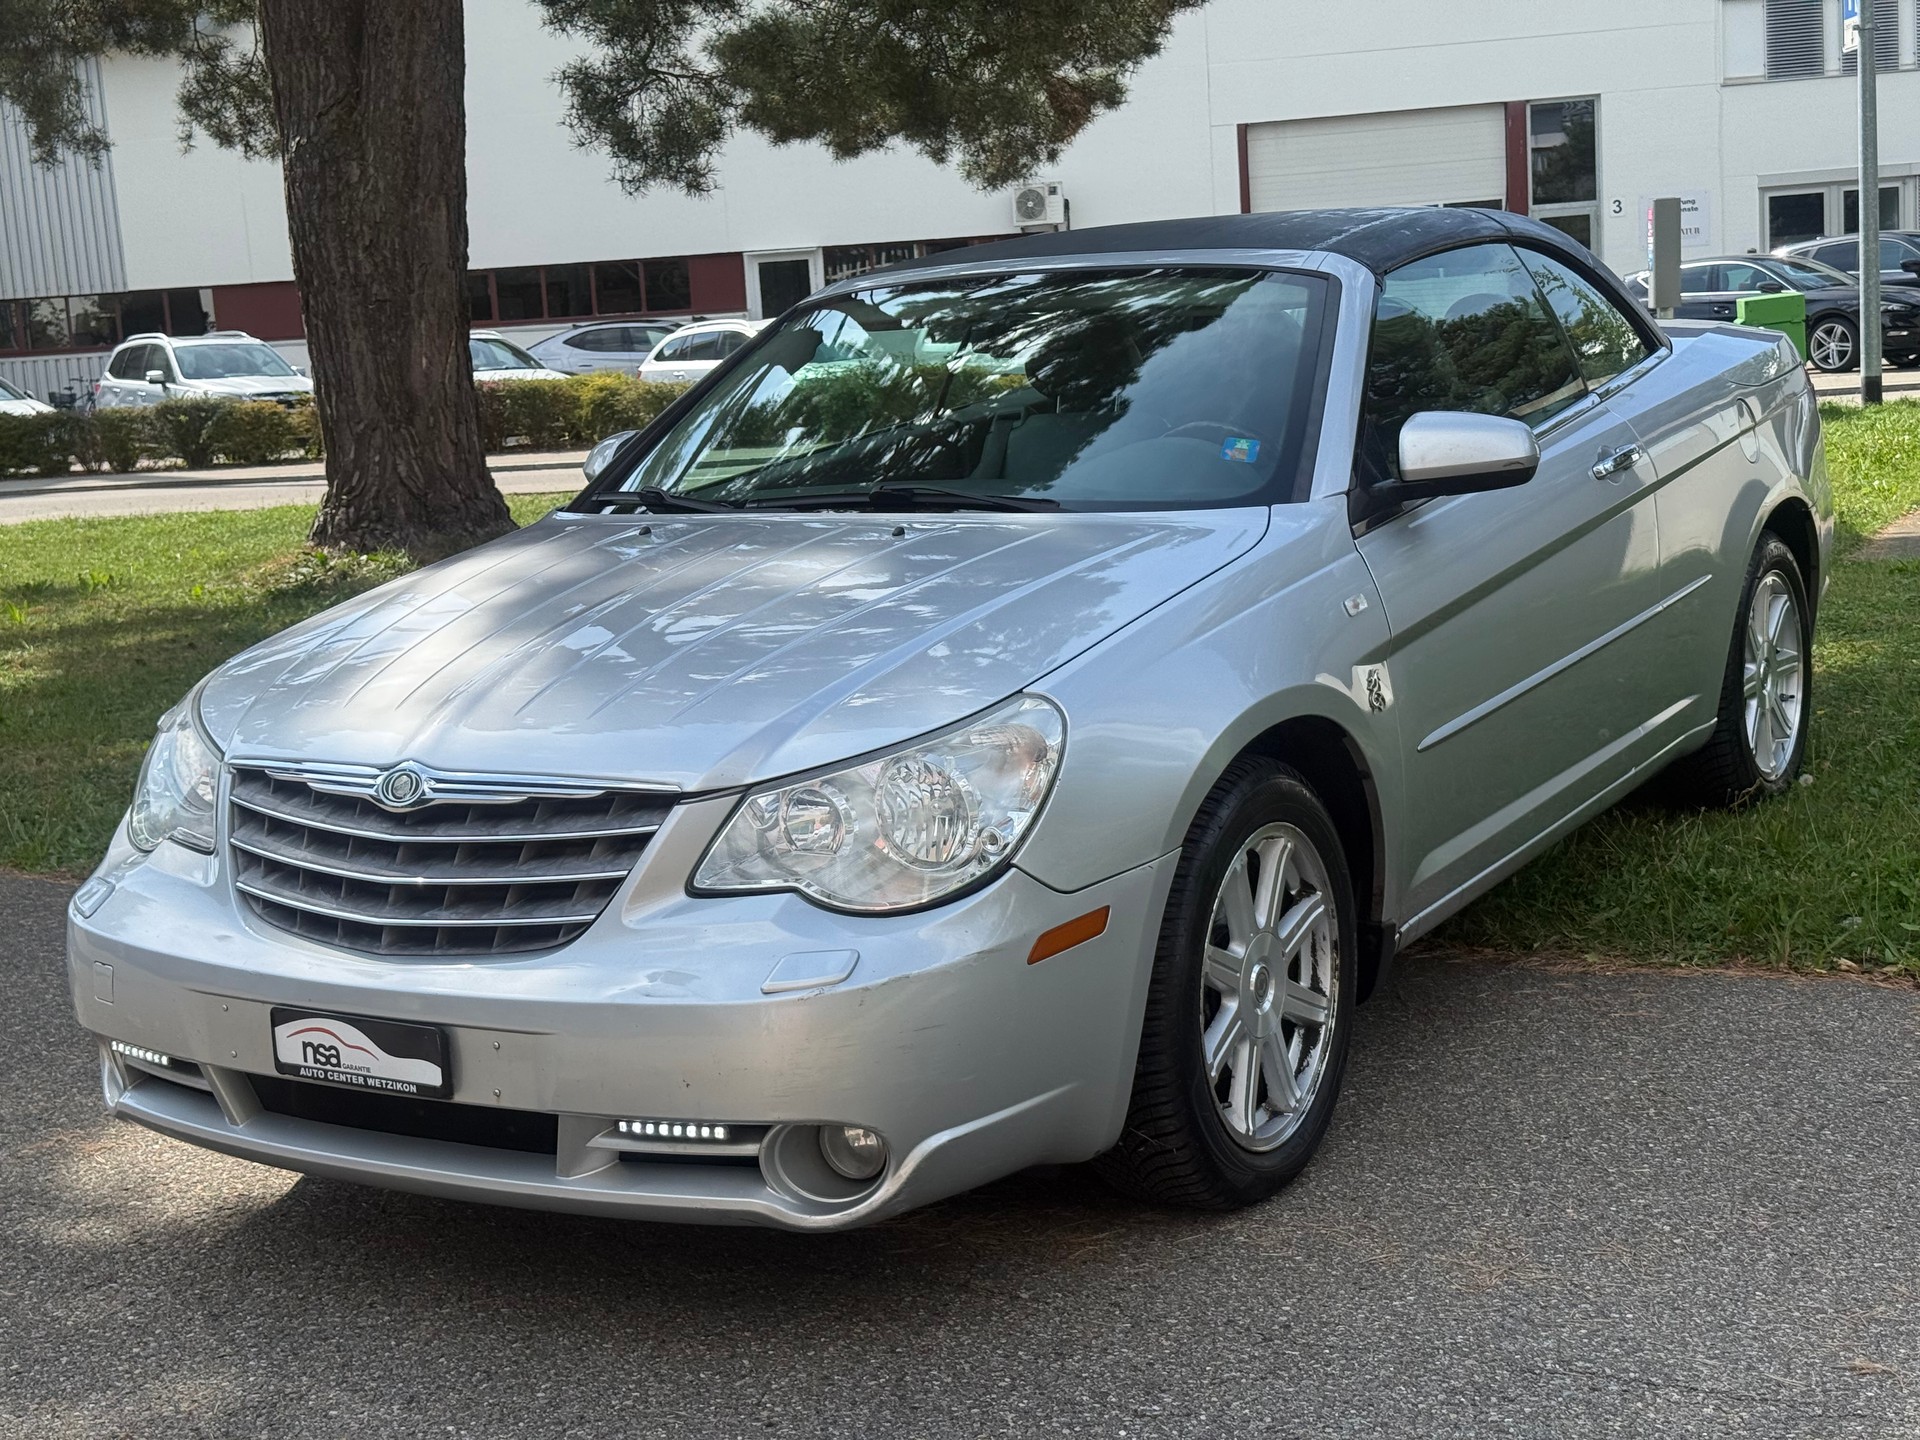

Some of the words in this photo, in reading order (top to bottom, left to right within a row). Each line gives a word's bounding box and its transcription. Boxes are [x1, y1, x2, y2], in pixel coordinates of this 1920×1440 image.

[1612, 199, 1622, 214] 3
[302, 1041, 341, 1068] nsa
[342, 1063, 371, 1073] GARANTIE
[300, 1067, 325, 1079] AUTO
[327, 1071, 365, 1085] CENTER
[367, 1077, 417, 1093] WETZIKON
